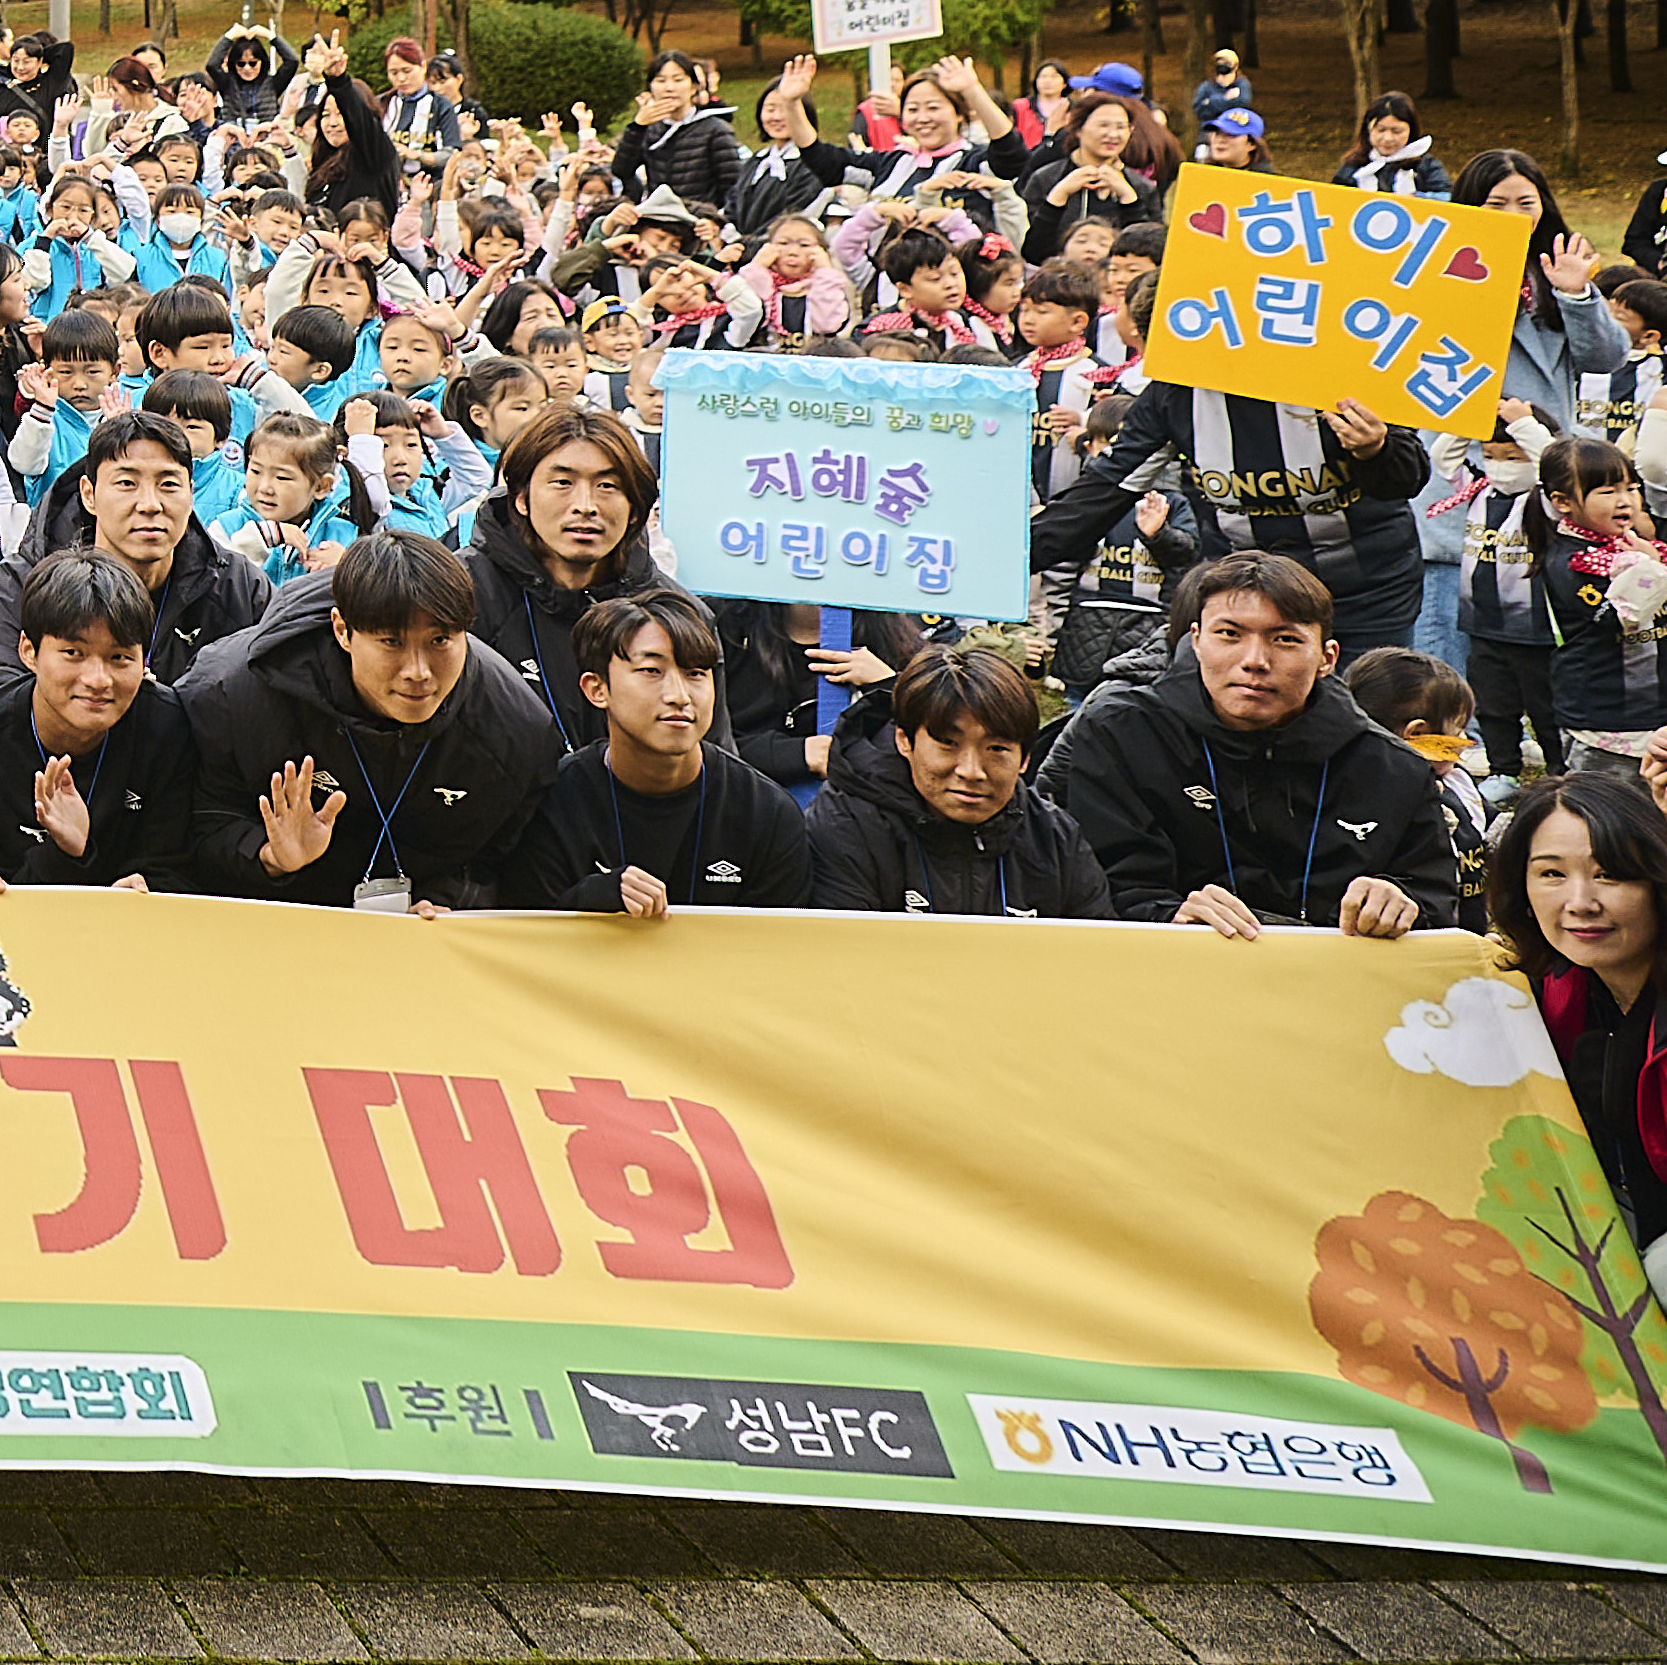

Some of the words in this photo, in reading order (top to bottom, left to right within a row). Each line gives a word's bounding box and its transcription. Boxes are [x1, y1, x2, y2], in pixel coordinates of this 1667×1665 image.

[848, 9, 910, 33] 어린이집
[1235, 188, 1449, 291] 하이
[1166, 274, 1496, 419] 어린이집
[697, 391, 779, 421] 사랑스런
[787, 398, 873, 427] 아이들의
[884, 404, 923, 431] 꿈과
[928, 408, 976, 439] 희망
[745, 447, 933, 526] 지혜숲
[719, 518, 957, 594] 어린이집
[300, 1064, 797, 1292] 대회
[397, 1380, 513, 1438] 후원
[724, 1395, 913, 1462] 성남FC
[1056, 1416, 1399, 1488] NH농협은행
